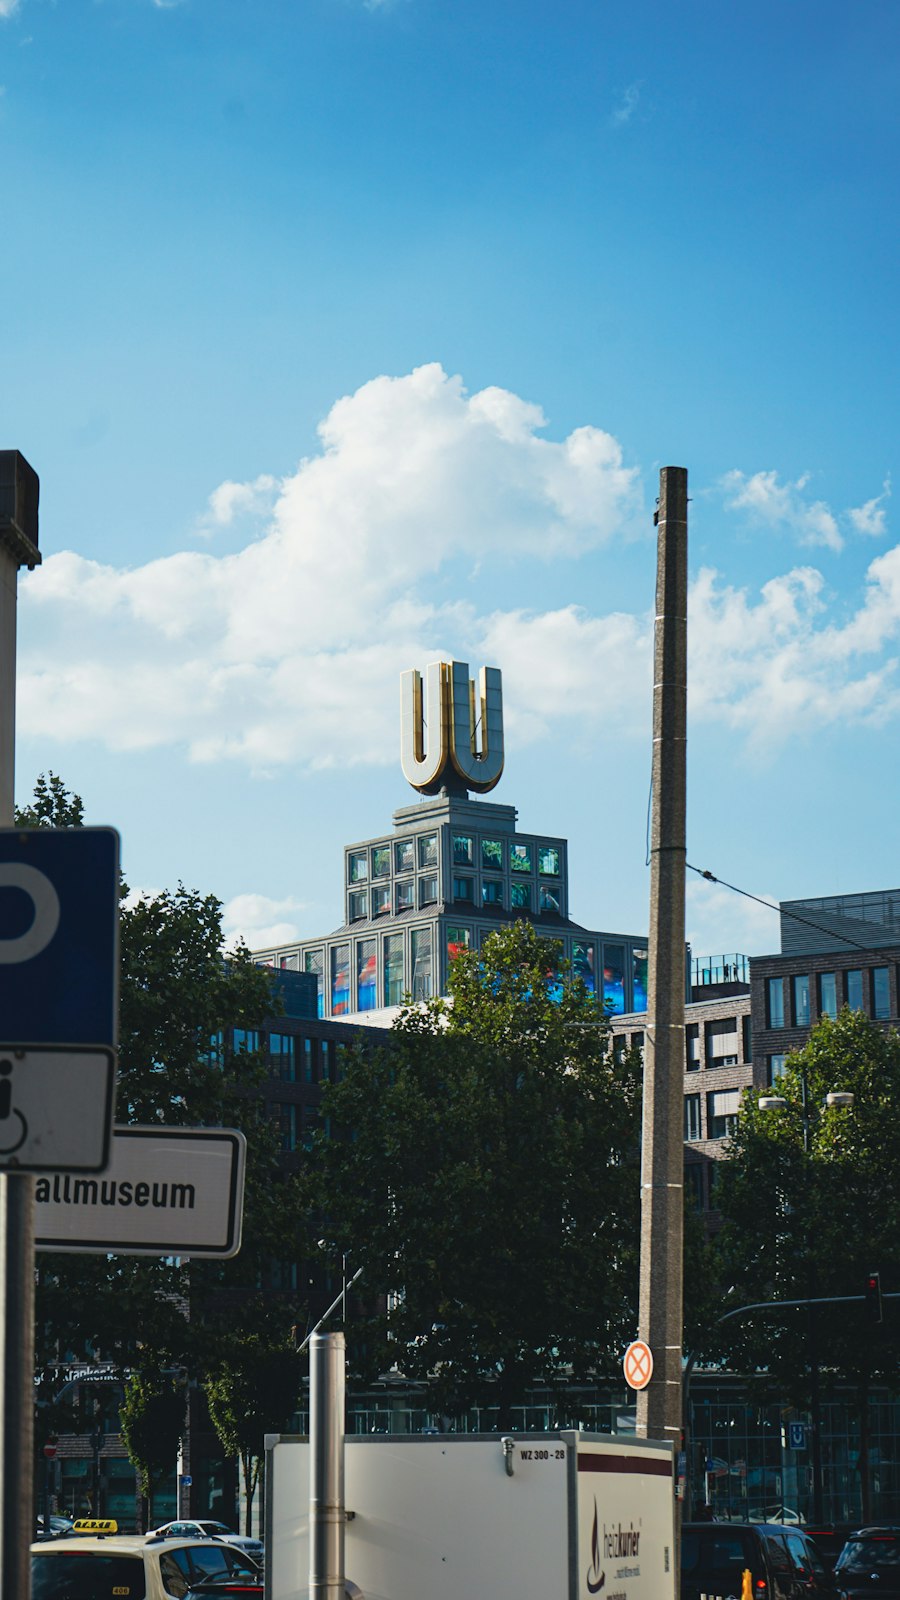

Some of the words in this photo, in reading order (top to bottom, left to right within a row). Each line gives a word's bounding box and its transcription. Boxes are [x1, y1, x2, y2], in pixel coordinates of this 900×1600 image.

[35, 1174, 196, 1209] allmuseum
[521, 1451, 533, 1460] WZ
[534, 1450, 549, 1460] 300
[555, 1450, 565, 1460] 28
